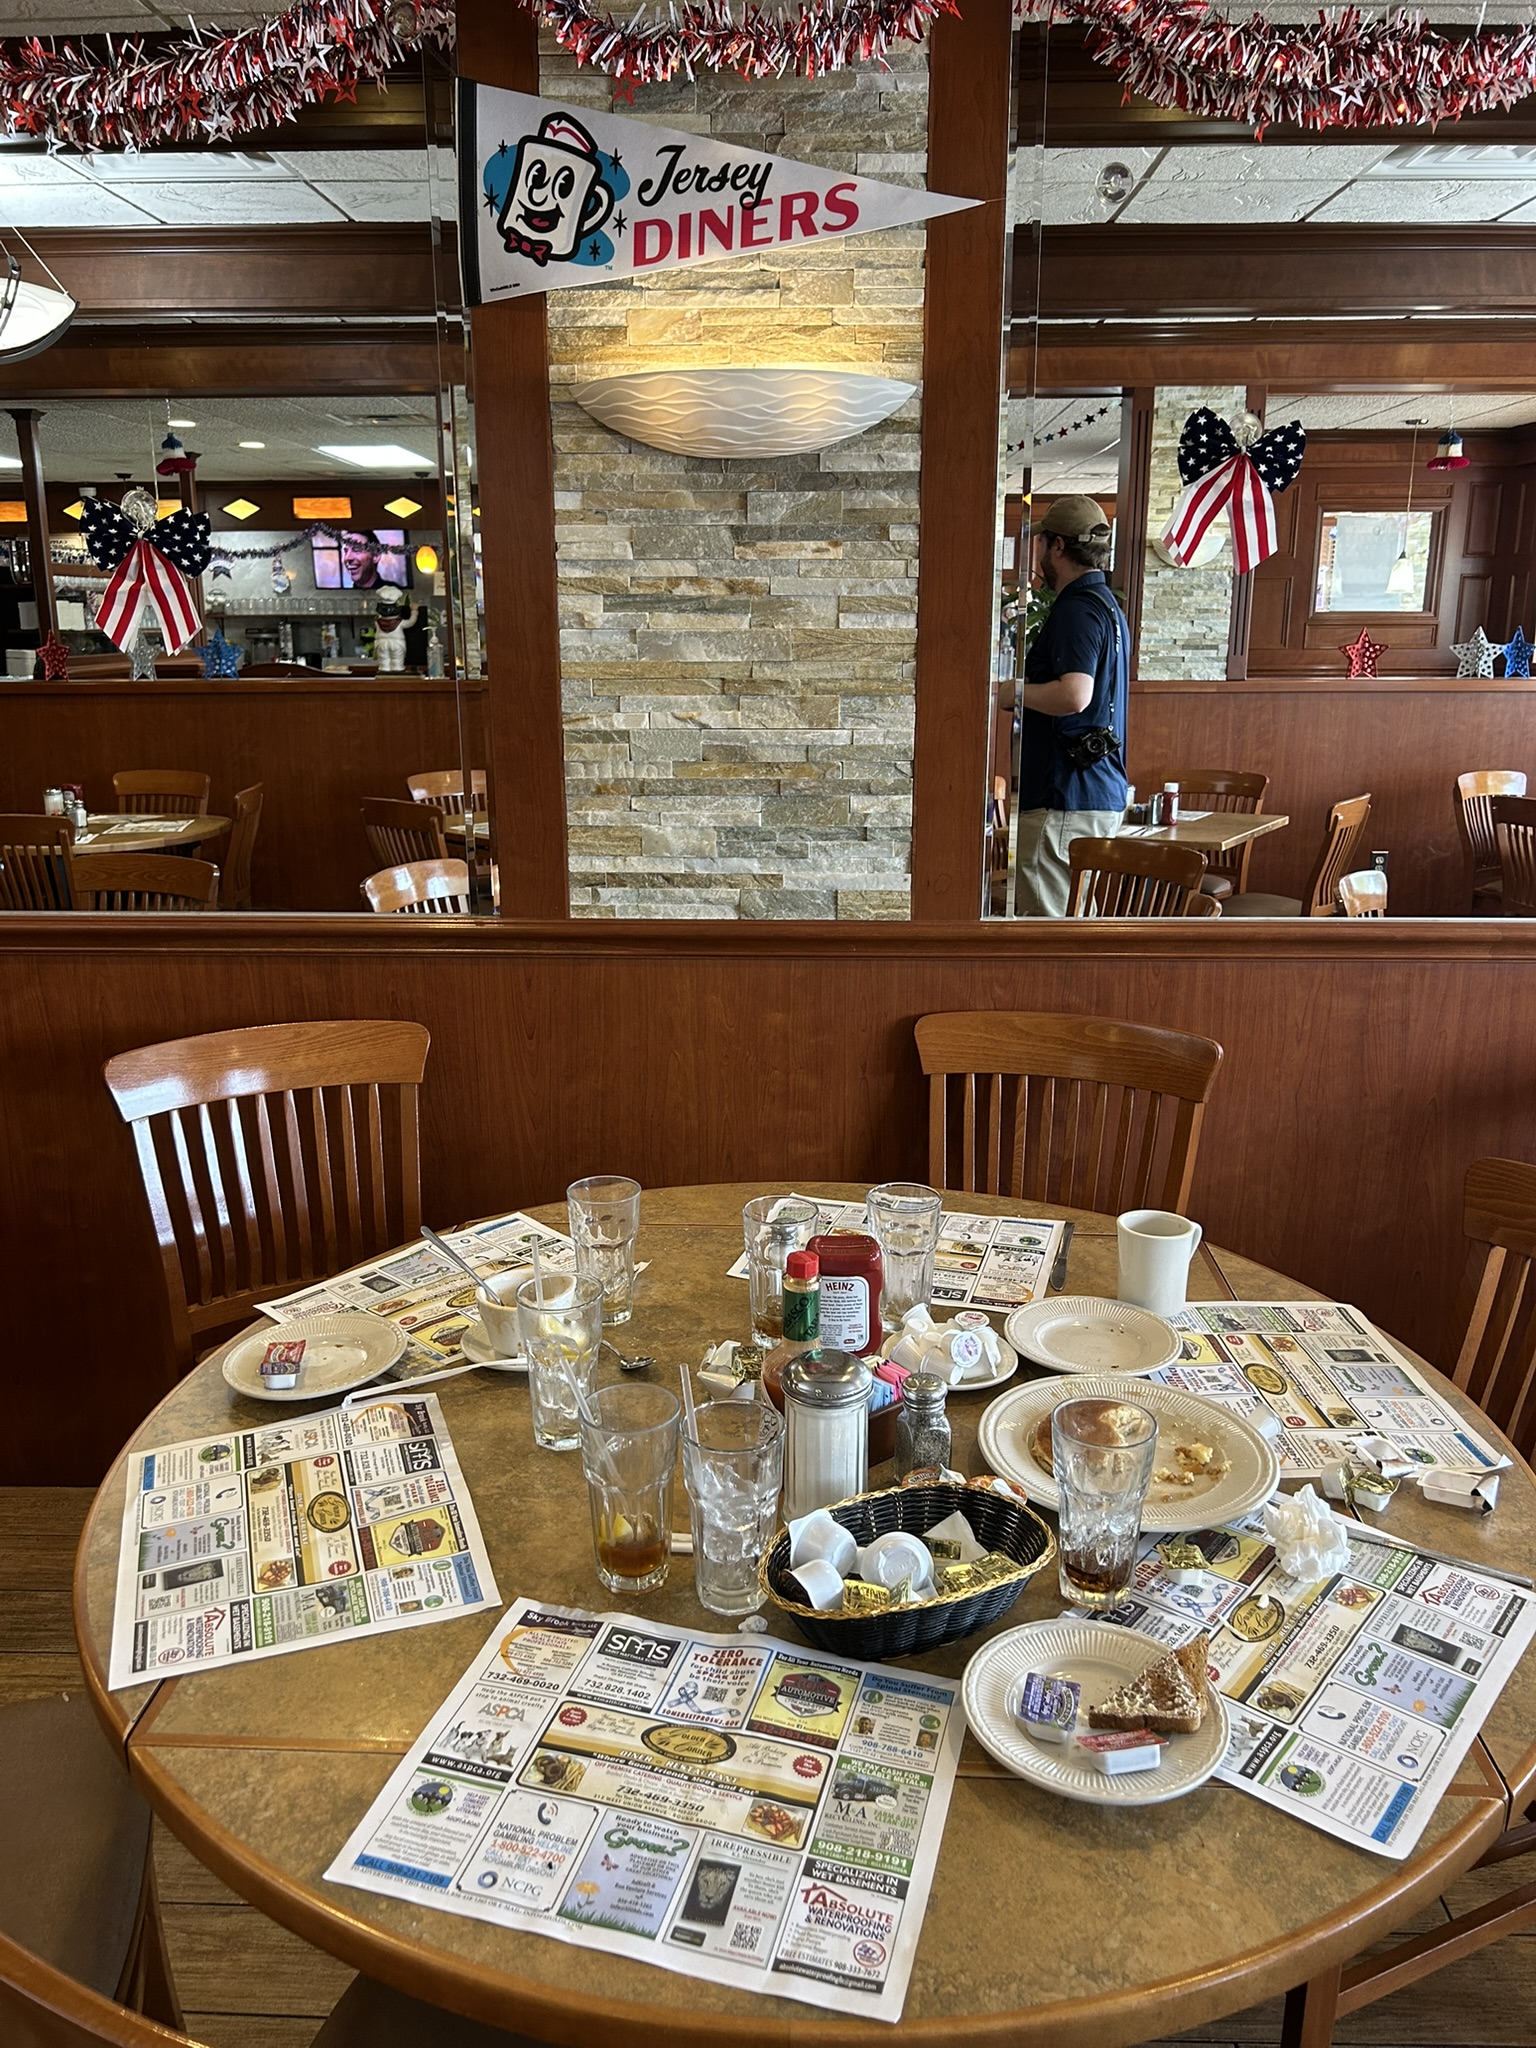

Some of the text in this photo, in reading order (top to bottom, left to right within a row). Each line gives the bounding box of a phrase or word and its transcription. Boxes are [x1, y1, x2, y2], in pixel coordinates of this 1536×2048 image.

[638, 145, 773, 210] Jersey
[633, 182, 860, 267] DINERS
[825, 1282, 855, 1292] HEINZ
[1396, 1563, 1419, 1591] SPECIALIZING
[1405, 1562, 1434, 1595] WET BASEMENTS
[1426, 1571, 1460, 1606] ABSOLUTE
[240, 1602, 251, 1648] SPECIALIZING IN
[526, 1612, 570, 1627] Sky Brook
[1371, 1598, 1399, 1634] IRREPRESSIBLE
[204, 1613, 220, 1656] ABSOLUTE
[1304, 1624, 1340, 1670] 732-469-3350
[604, 1647, 619, 1656] SAINT
[619, 1650, 645, 1662] MATTHIAS
[645, 1656, 666, 1665] SCHOOL
[692, 1653, 764, 1667] TOLERANCE
[712, 1649, 744, 1660] ZERO
[788, 1655, 797, 1663] All
[797, 1657, 810, 1666] Your
[810, 1660, 841, 1672] Automotive
[842, 1666, 859, 1676] Needs
[486, 1671, 560, 1692] 732-469-0020
[689, 1672, 750, 1687] be their voice
[690, 1662, 756, 1676] for child abuse
[695, 1669, 729, 1680] SPEAK
[481, 1687, 497, 1696] Help
[497, 1688, 508, 1696] the
[508, 1690, 529, 1700] ASPCA
[530, 1696, 543, 1704] put
[584, 1678, 652, 1700] 732.828.1402
[781, 1684, 837, 1704] AUTOMOTIVE
[871, 1675, 949, 1697] Do You Suffer From
[875, 1682, 942, 1702] Spinal Stenosis?
[475, 1692, 490, 1701] stop
[499, 1696, 522, 1706] animal
[521, 1700, 546, 1711] cruelty.
[478, 1702, 527, 1722] ASPCA
[576, 1692, 642, 1711] www.stmatthias.info
[662, 1708, 741, 1727] SOMERSETPROSNJ.GOV
[752, 1721, 838, 1747] 732-893-8777
[1359, 1710, 1392, 1755] 1-800-522-4700
[1406, 1730, 1428, 1756] NCPG
[862, 1739, 923, 1759] 908-788-6410
[1245, 1729, 1284, 1775] www.aspca.org
[431, 1755, 502, 1780] www.aspca.org
[619, 1750, 738, 1784] DINER RESTAURANT
[628, 1760, 653, 1772] Good
[653, 1765, 690, 1781] Friends
[691, 1775, 716, 1787] Meet
[717, 1782, 738, 1792] and
[841, 1763, 928, 1788] RECYCLABLE METALS!
[863, 1762, 880, 1771] PAY
[881, 1766, 903, 1776] CASH
[903, 1771, 920, 1780] FOR
[606, 1763, 632, 1774] PREMISE
[633, 1768, 663, 1783] CATERING
[665, 1777, 692, 1790] QUALITY
[718, 1790, 744, 1802] SERVICE
[616, 1785, 706, 1812] 732-469-3350
[498, 1822, 579, 1847] NATIONAL PROBLEM
[615, 1814, 680, 1836] Ready to watch
[616, 1822, 675, 1841] your business
[490, 1839, 566, 1864] 1-800-522-4700
[493, 1830, 573, 1855] GAMBLING HELPLINE
[603, 1827, 690, 1857] Grow?
[711, 1838, 792, 1865] IRREPRESSIBLE
[818, 1840, 908, 1868] 908-218-9191
[485, 1848, 532, 1865] CALL TEXT
[360, 1868, 394, 1881] ADVERTISE
[361, 1855, 445, 1884] CALL 908-231-7109
[812, 1868, 898, 1896] WET BASEMENTS
[814, 1860, 885, 1883] SPECIALIZING
[886, 1876, 899, 1887] IN
[501, 1876, 544, 1898] NCPG
[808, 1904, 892, 1934] WATERPROOFING
[810, 1891, 894, 1925] ABSOLUTE
[804, 1915, 813, 1923] &
[814, 1914, 886, 1942] RENOVATIONS
[780, 1948, 798, 1959] FREE
[798, 1951, 834, 1967] ESTIMATES
[833, 1960, 881, 1979] 908-333-7672
